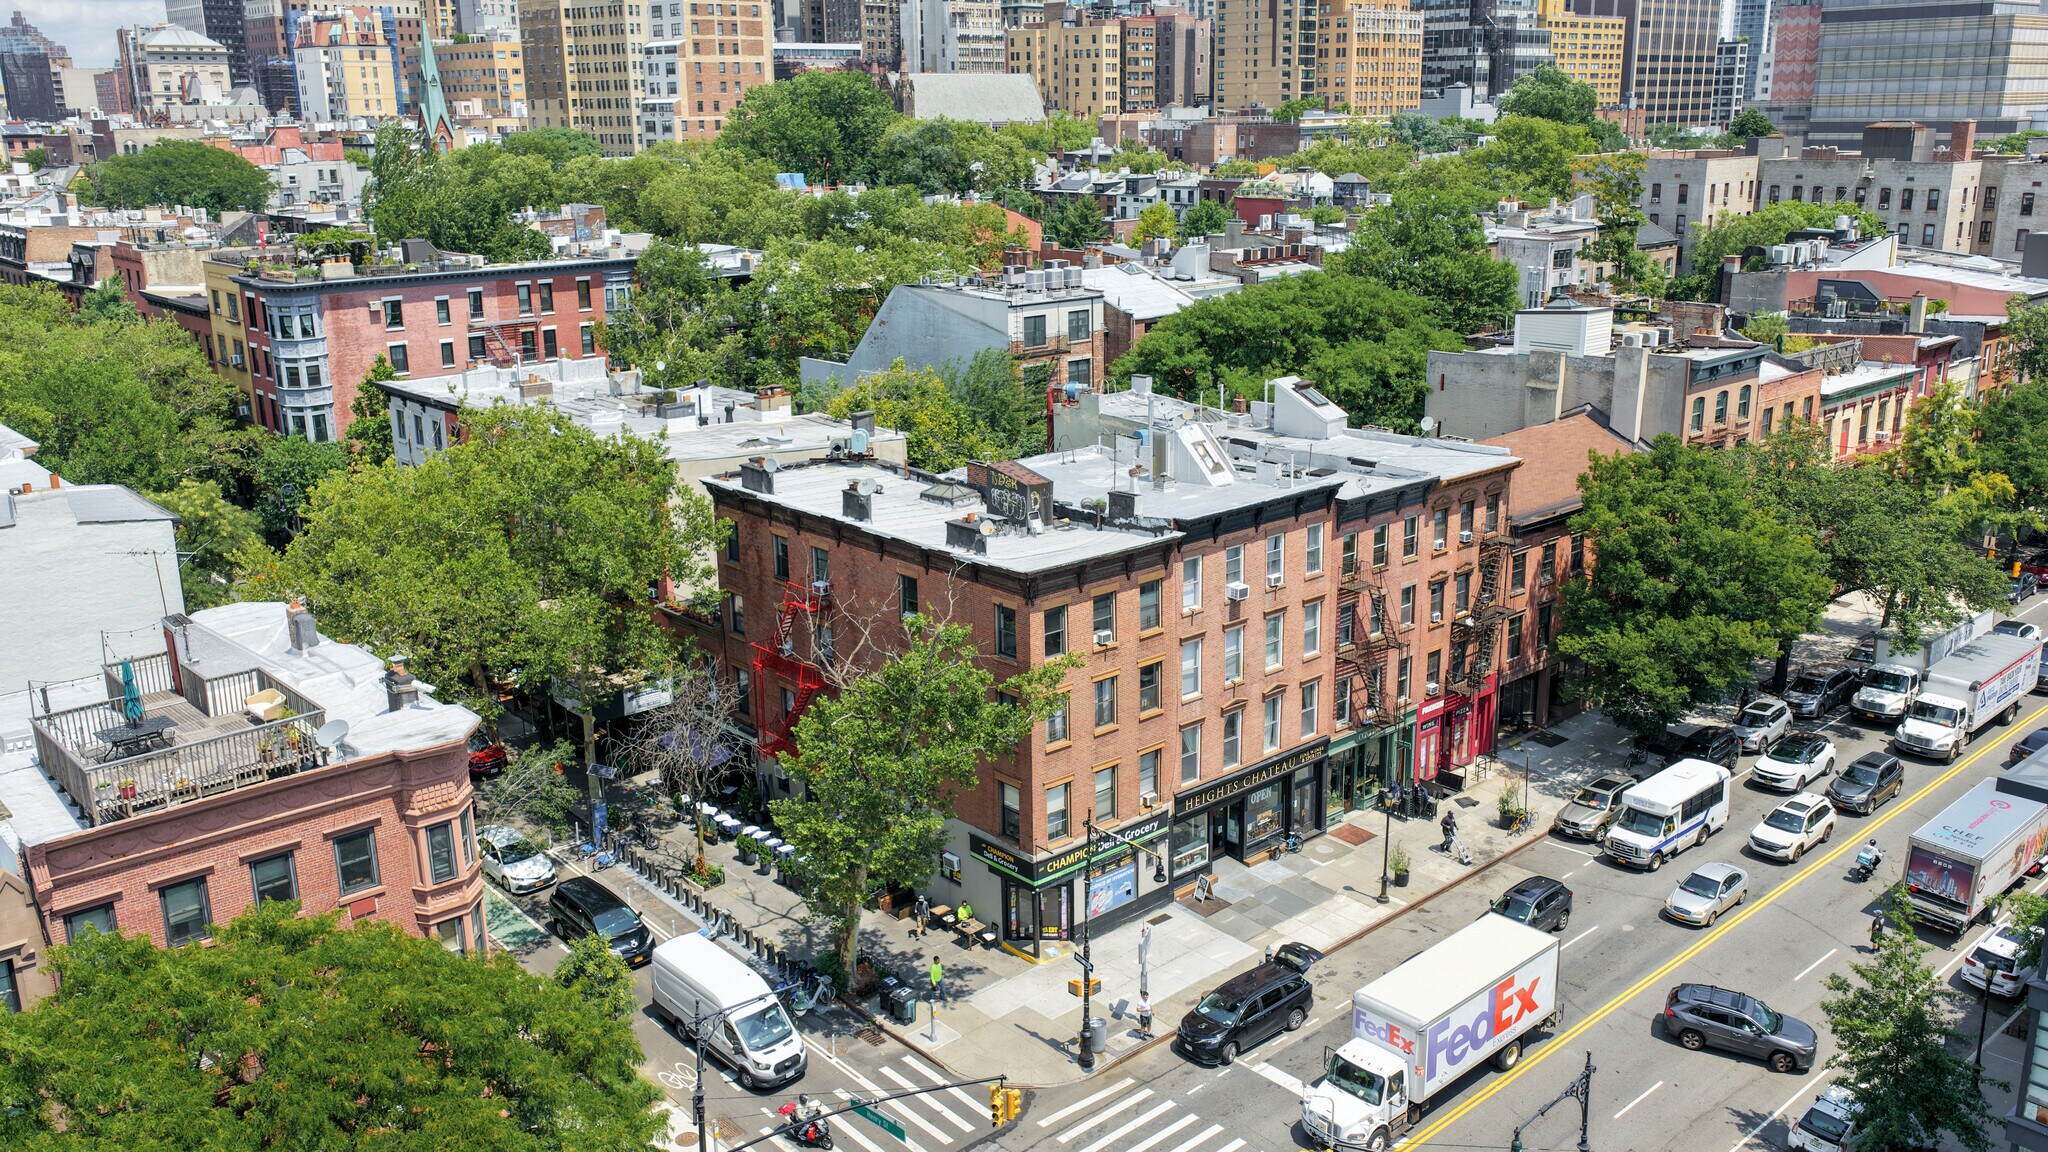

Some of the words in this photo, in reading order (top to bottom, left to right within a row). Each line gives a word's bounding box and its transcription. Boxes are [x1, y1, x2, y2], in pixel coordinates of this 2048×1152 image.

[1456, 706, 1469, 716] PIZZA
[1422, 721, 1436, 731] WINE
[1185, 780, 1239, 811] HEIGHTS
[1243, 757, 1296, 787] CHATEAU
[1251, 786, 1272, 804] OPEN
[1098, 836, 1115, 852] Deli
[1125, 820, 1159, 841] Grocery
[1932, 832, 1974, 849] LISTED
[1942, 825, 1985, 841] CHEF
[983, 850, 993, 861] Deli
[998, 858, 1019, 873] Grocery
[987, 845, 1015, 863] CHAMPION
[1354, 1008, 1415, 1055] FedEx
[1426, 974, 1541, 1083] FedEx
[1492, 1026, 1517, 1048] Express
[866, 1110, 882, 1126] Henry
[882, 1120, 889, 1129] St
